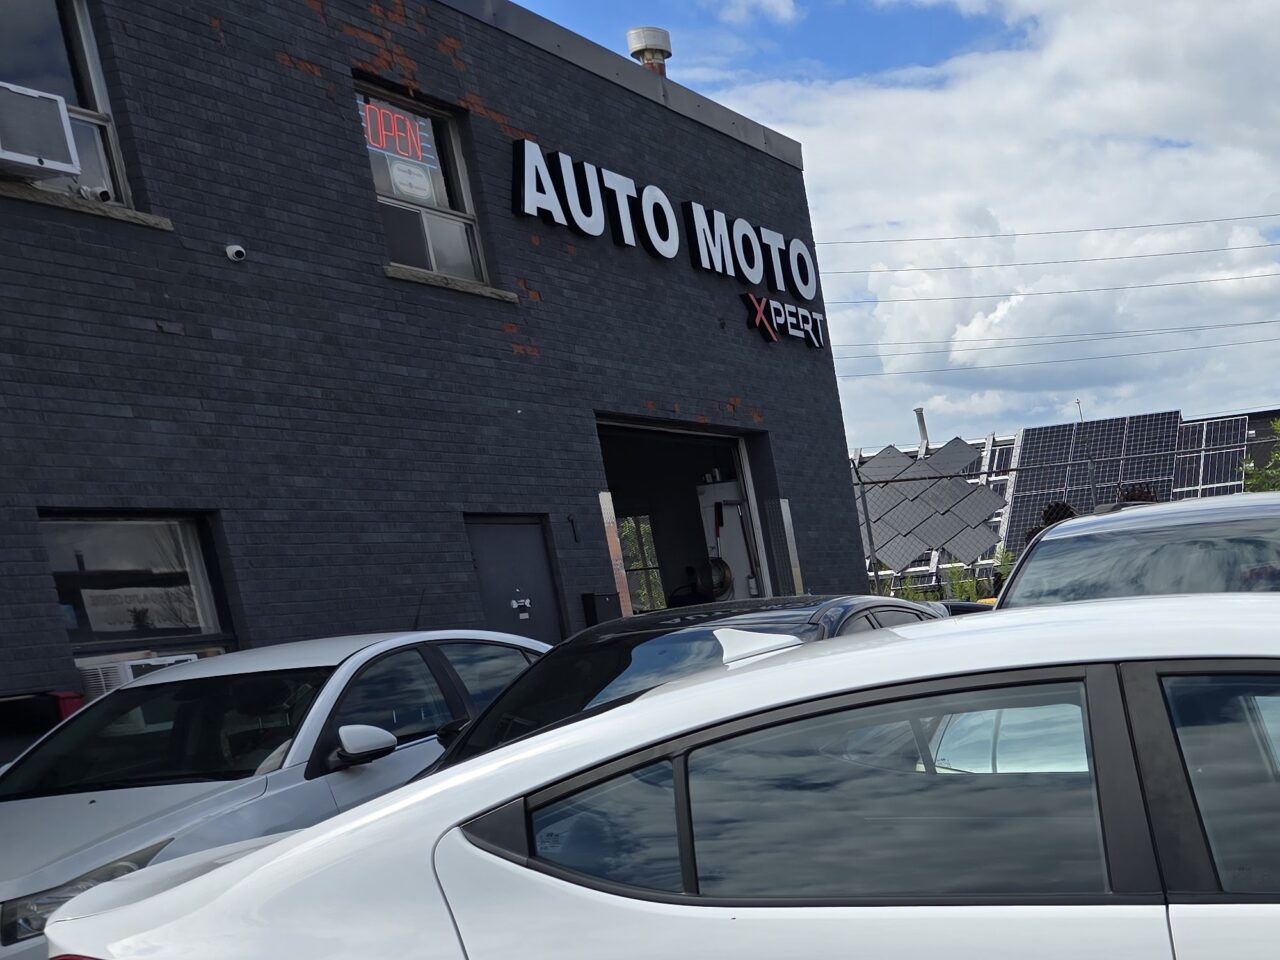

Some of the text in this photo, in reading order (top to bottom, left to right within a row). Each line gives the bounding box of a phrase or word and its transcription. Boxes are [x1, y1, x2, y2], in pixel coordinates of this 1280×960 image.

[365, 103, 423, 161] OPEN
[523, 138, 818, 301] AUTO MOTO
[748, 293, 824, 348] XPERT
